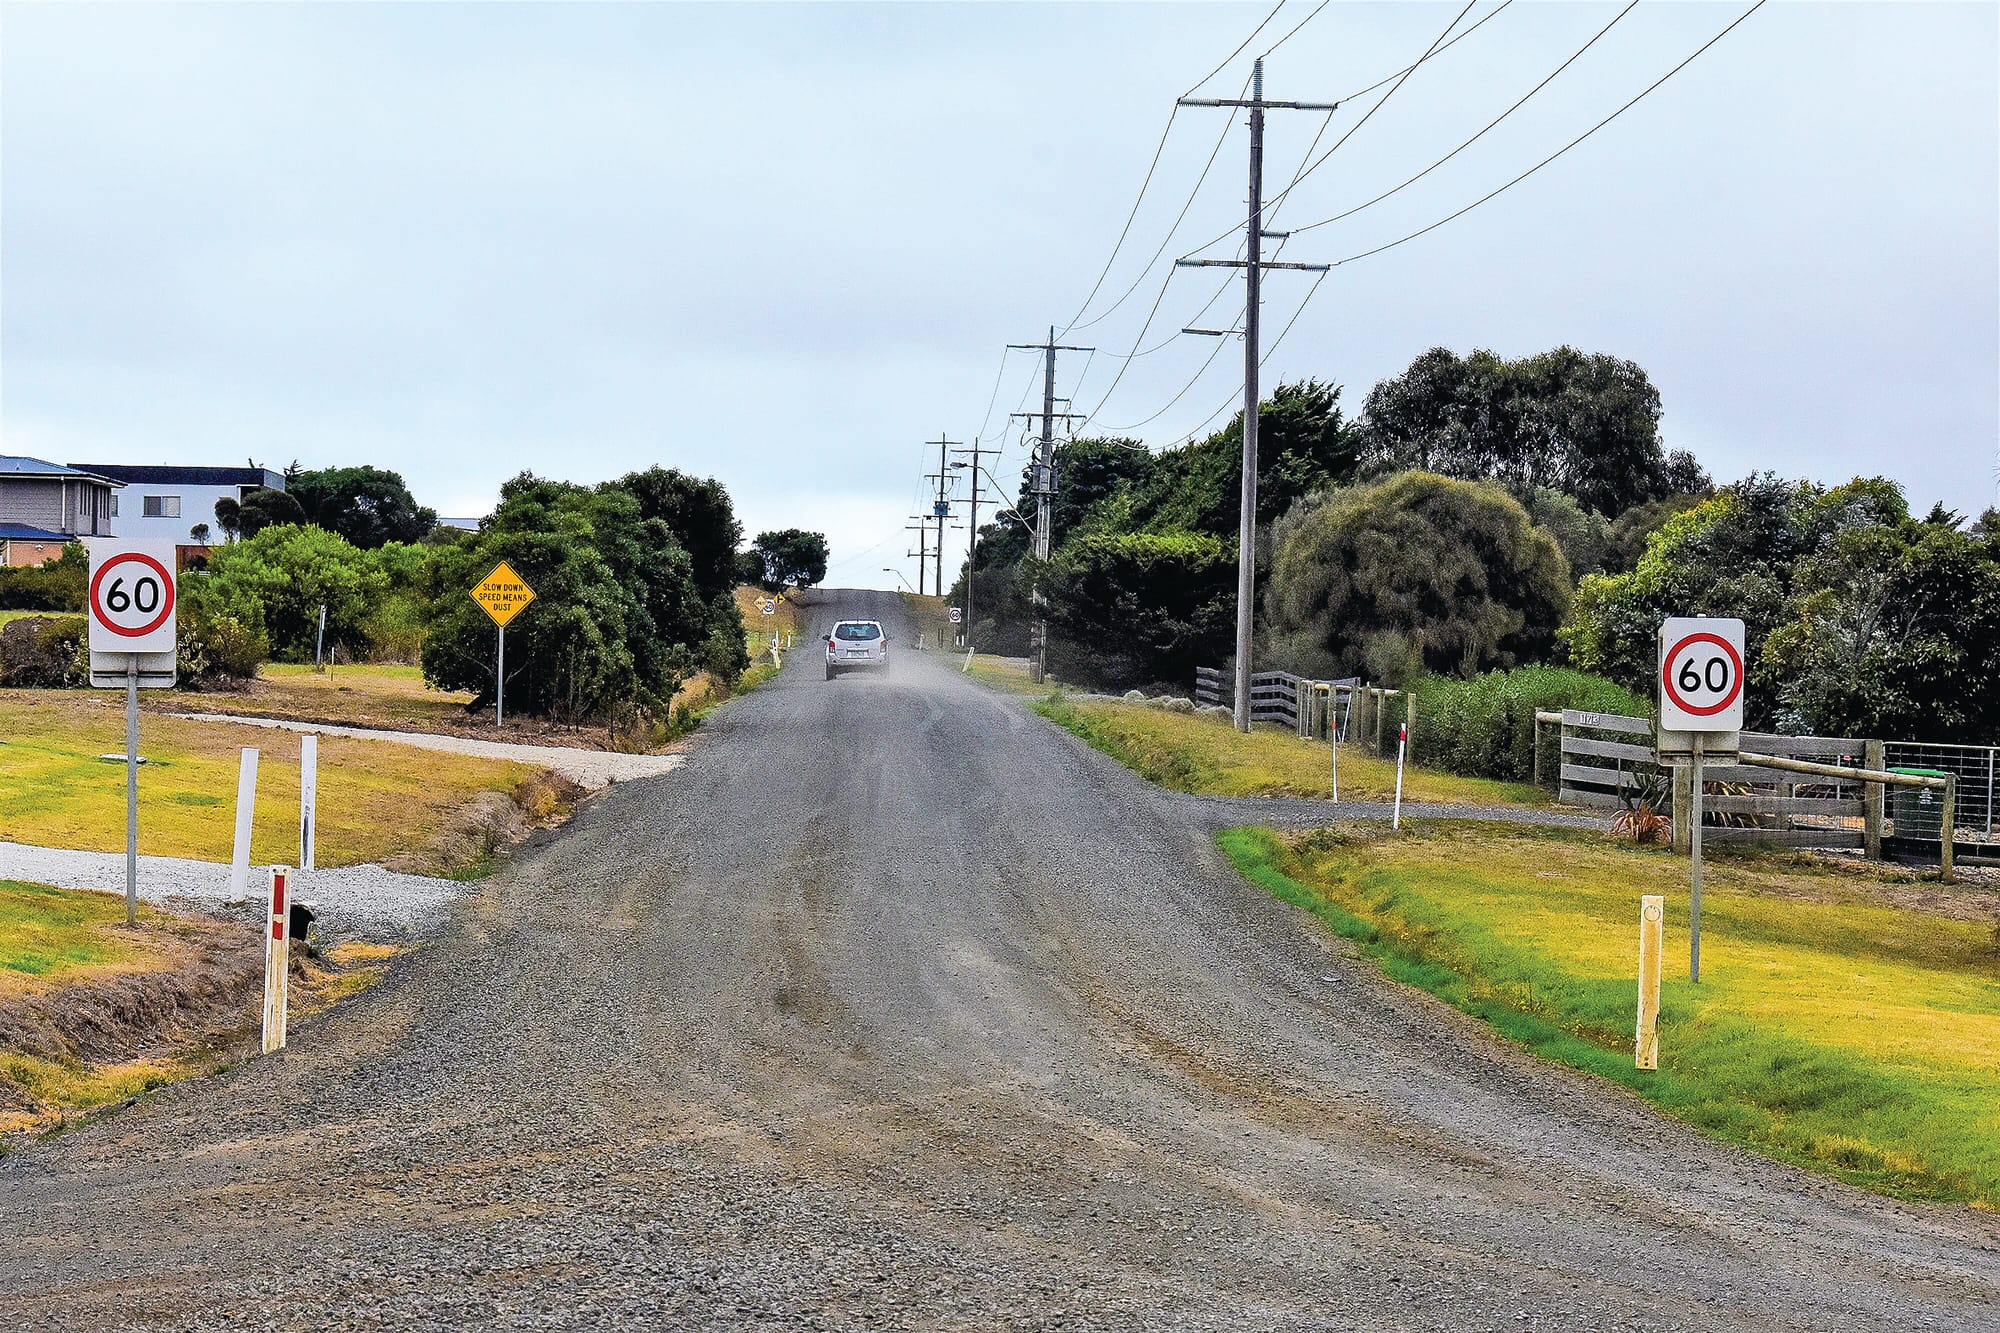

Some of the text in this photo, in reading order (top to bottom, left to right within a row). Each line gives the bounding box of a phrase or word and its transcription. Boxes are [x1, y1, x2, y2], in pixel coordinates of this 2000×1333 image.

[483, 583, 524, 592] SLOW DOWN
[107, 577, 159, 613] 60
[478, 593, 527, 602] SPEED MEANS
[493, 603, 512, 611] DUST
[1679, 657, 1728, 693] 60
